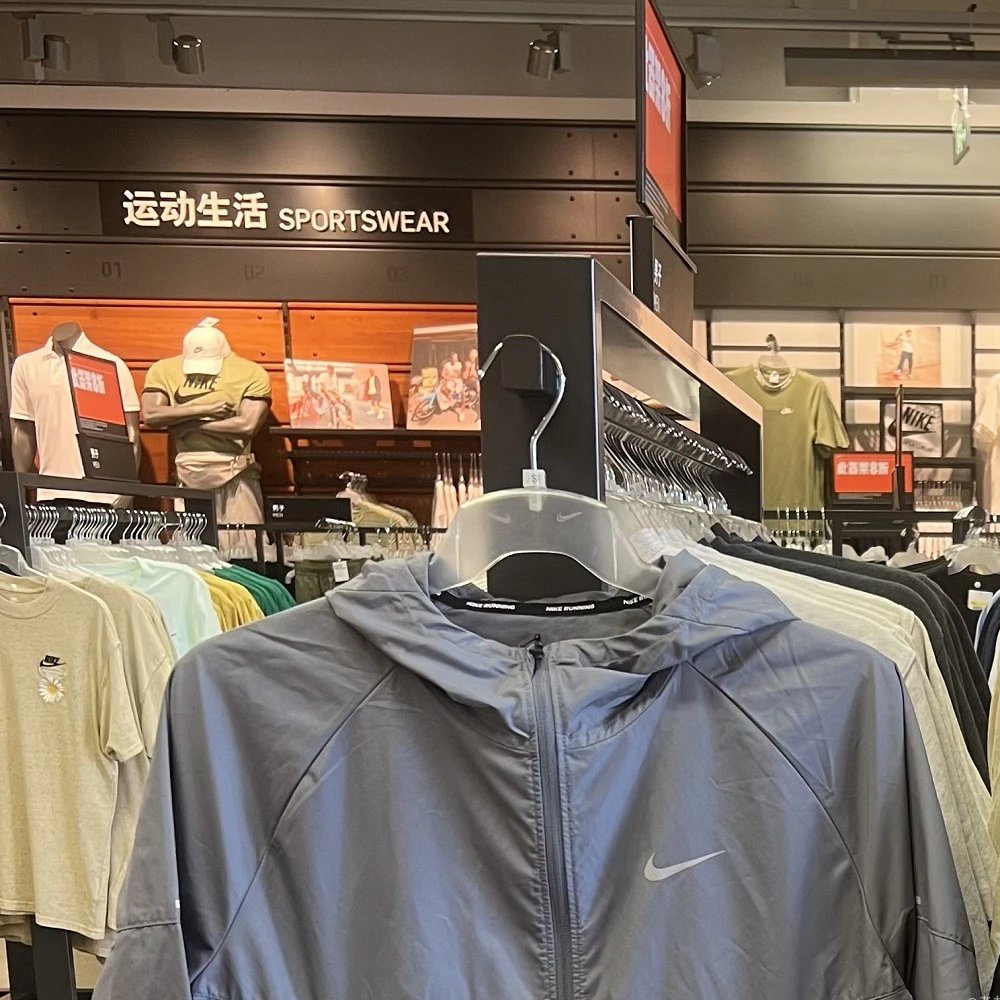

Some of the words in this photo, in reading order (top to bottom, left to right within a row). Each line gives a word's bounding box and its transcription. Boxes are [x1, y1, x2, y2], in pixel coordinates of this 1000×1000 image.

[123, 189, 268, 230] 运动生活
[278, 207, 450, 234] SPORTSWEAR
[101, 261, 121, 279] 01
[244, 264, 264, 280] 02
[903, 406, 935, 432] NIKE
